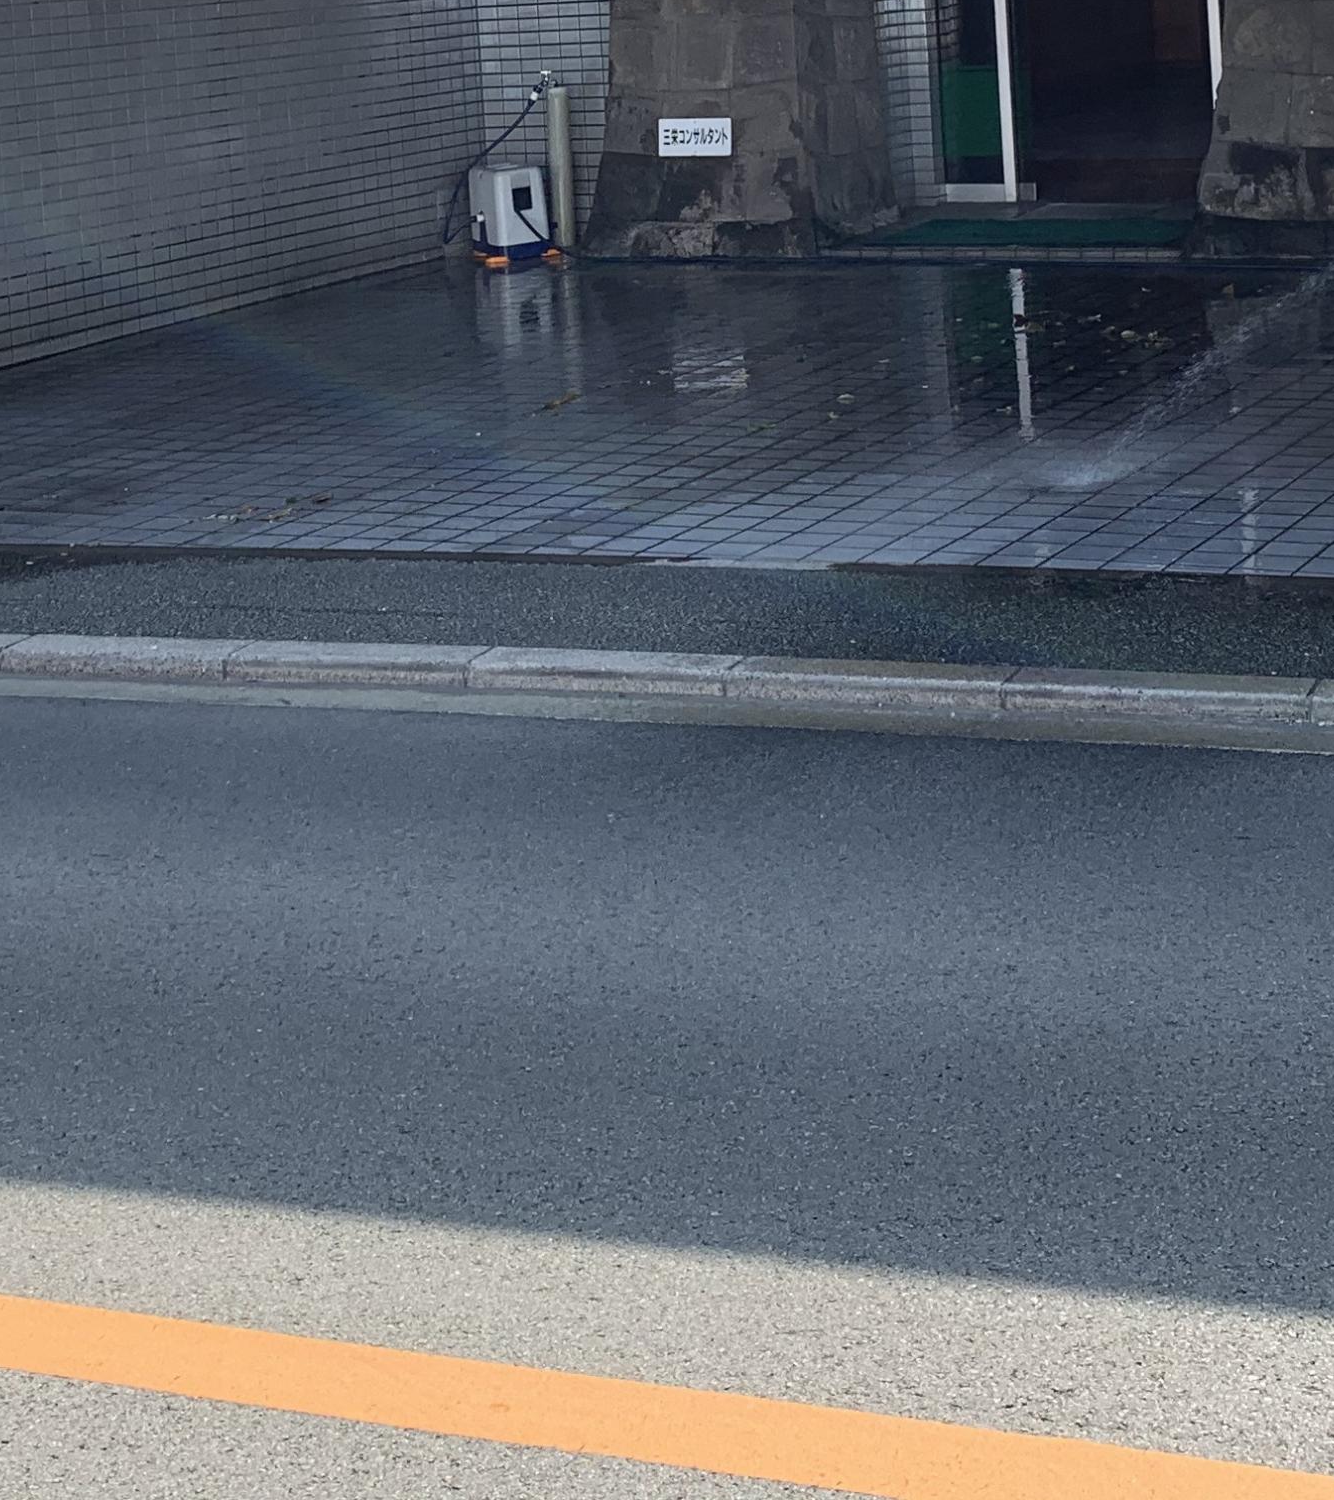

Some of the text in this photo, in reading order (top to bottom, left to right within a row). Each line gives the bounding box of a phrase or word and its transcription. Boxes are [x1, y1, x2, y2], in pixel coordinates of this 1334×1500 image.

[663, 127, 729, 146] 三栄コンサルタント
